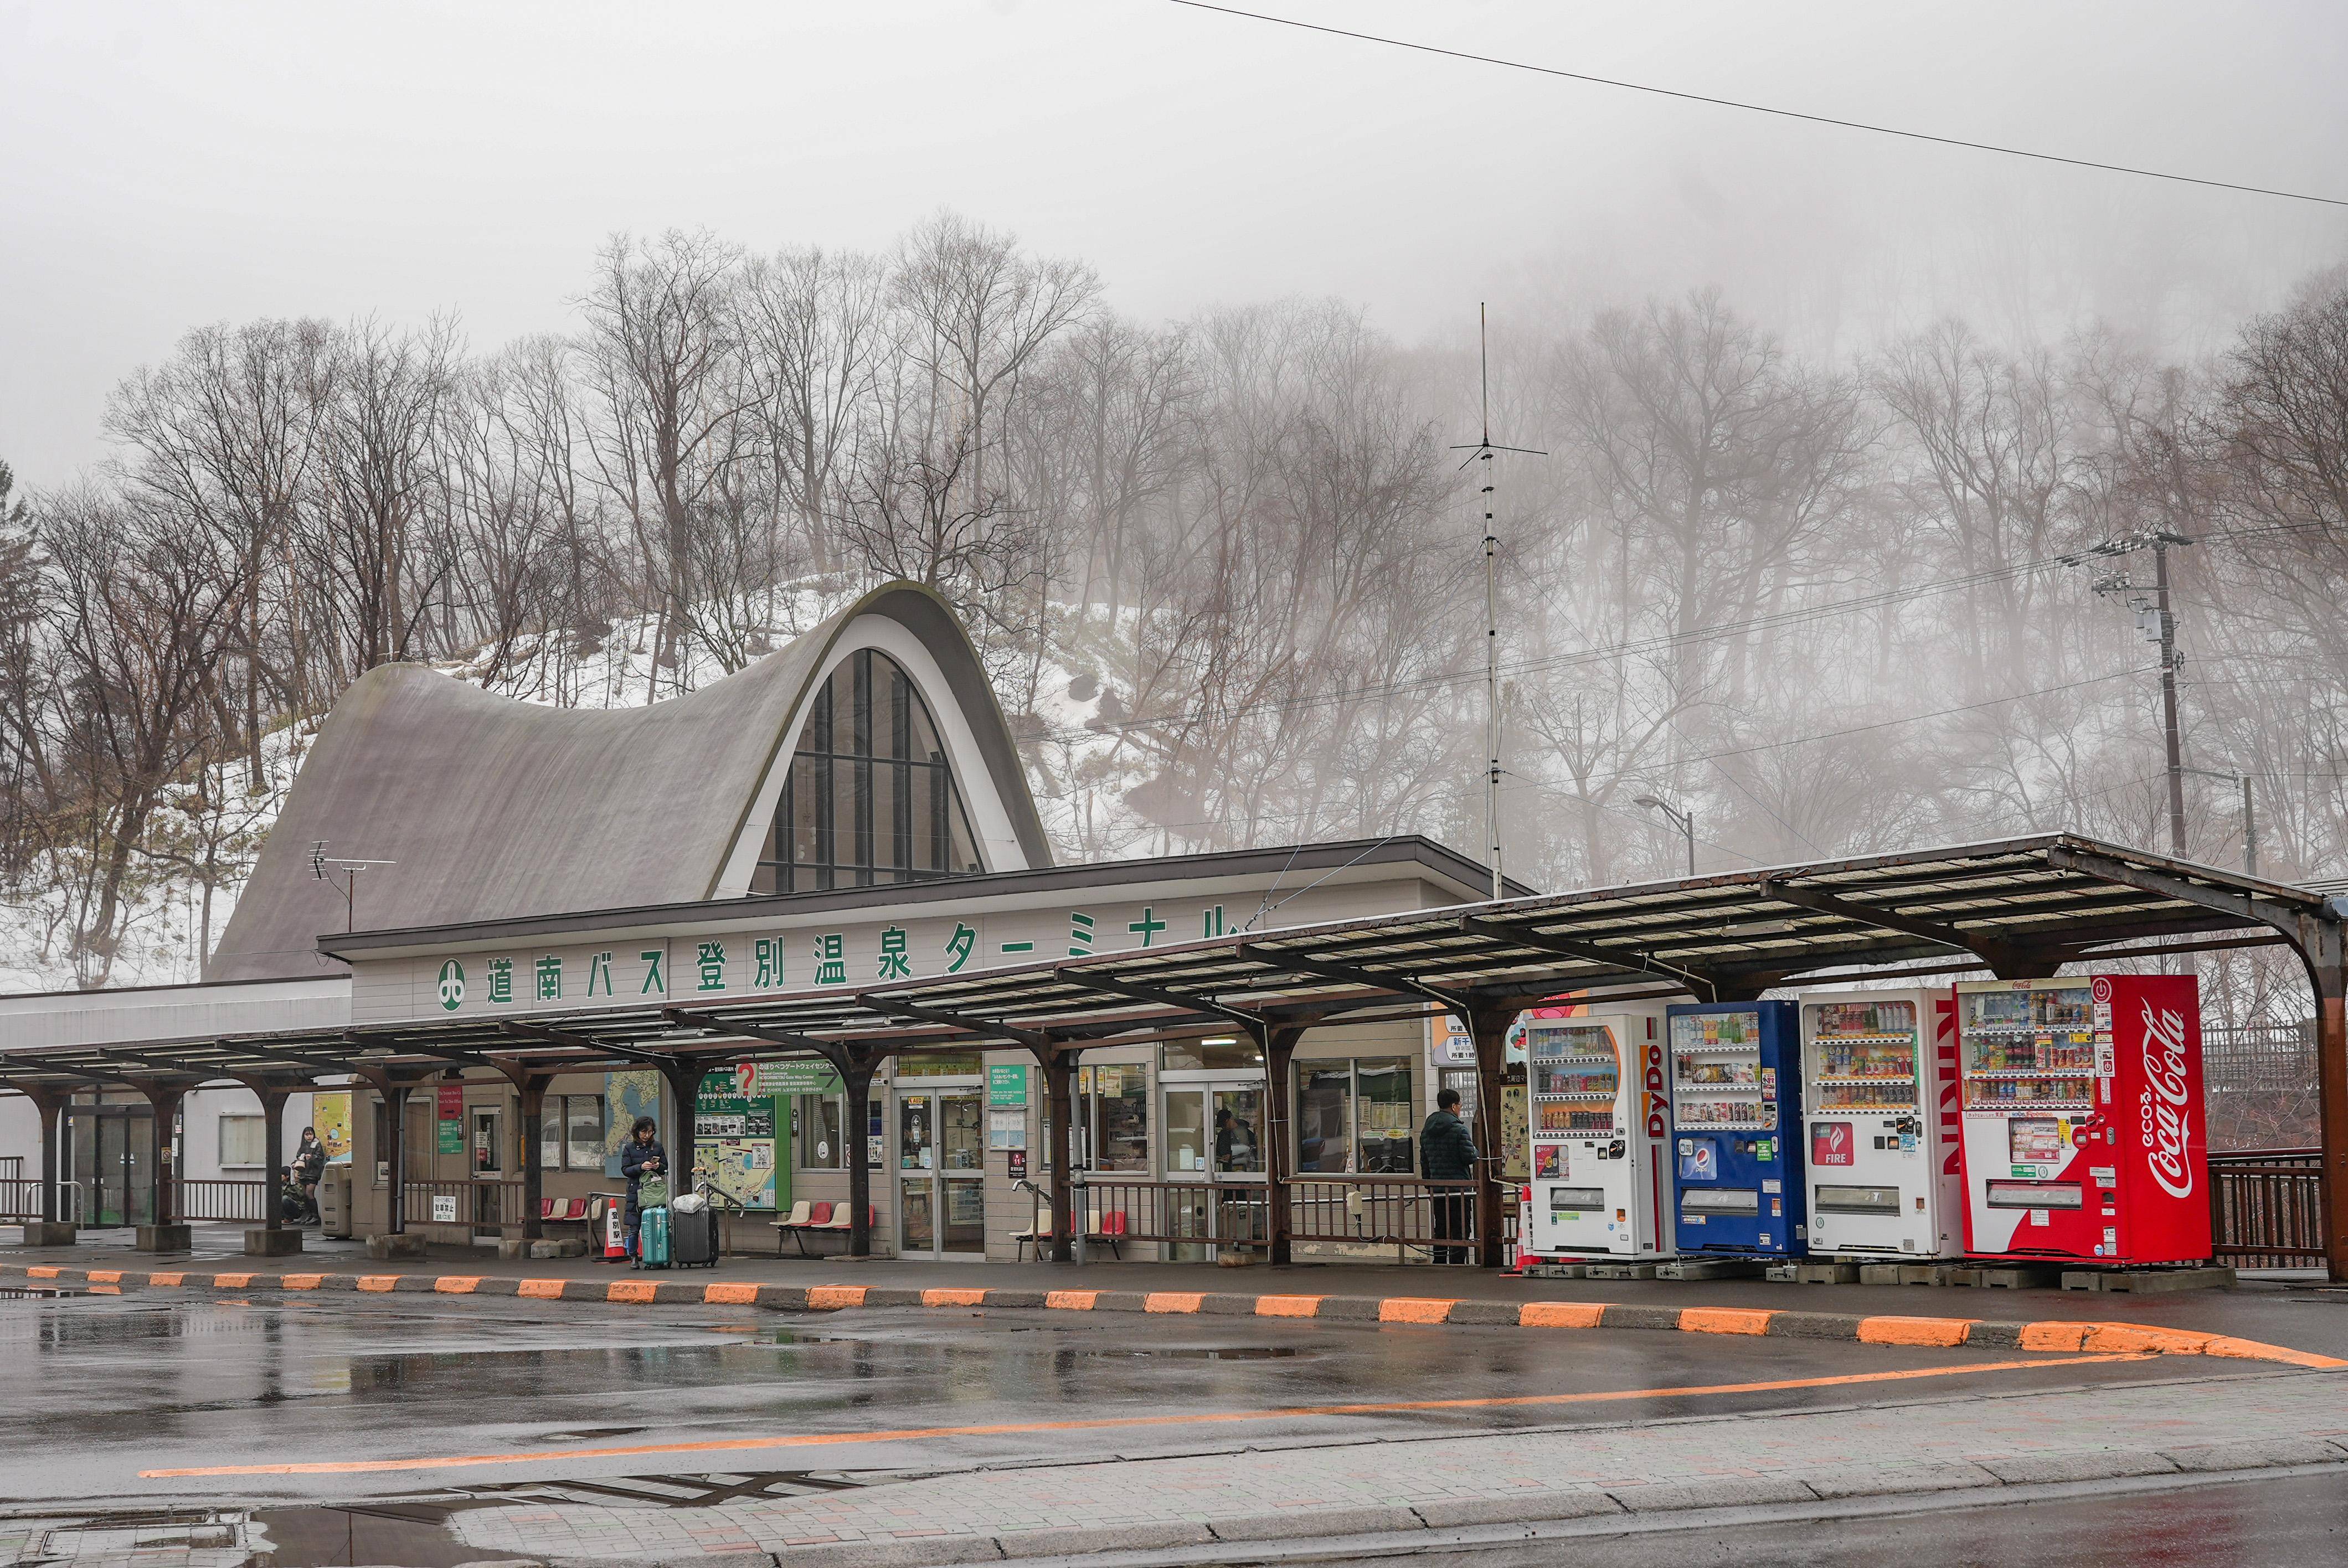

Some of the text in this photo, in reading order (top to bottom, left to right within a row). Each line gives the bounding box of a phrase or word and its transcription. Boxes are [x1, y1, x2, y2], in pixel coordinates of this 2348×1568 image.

[2012, 981, 2032, 989] Coca-Cola
[1453, 1036, 1474, 1045] 新千
[2141, 997, 2193, 1199] Coca-Cola
[1825, 1154, 1846, 1164] FIRE
[611, 1211, 621, 1239] 登別駅
